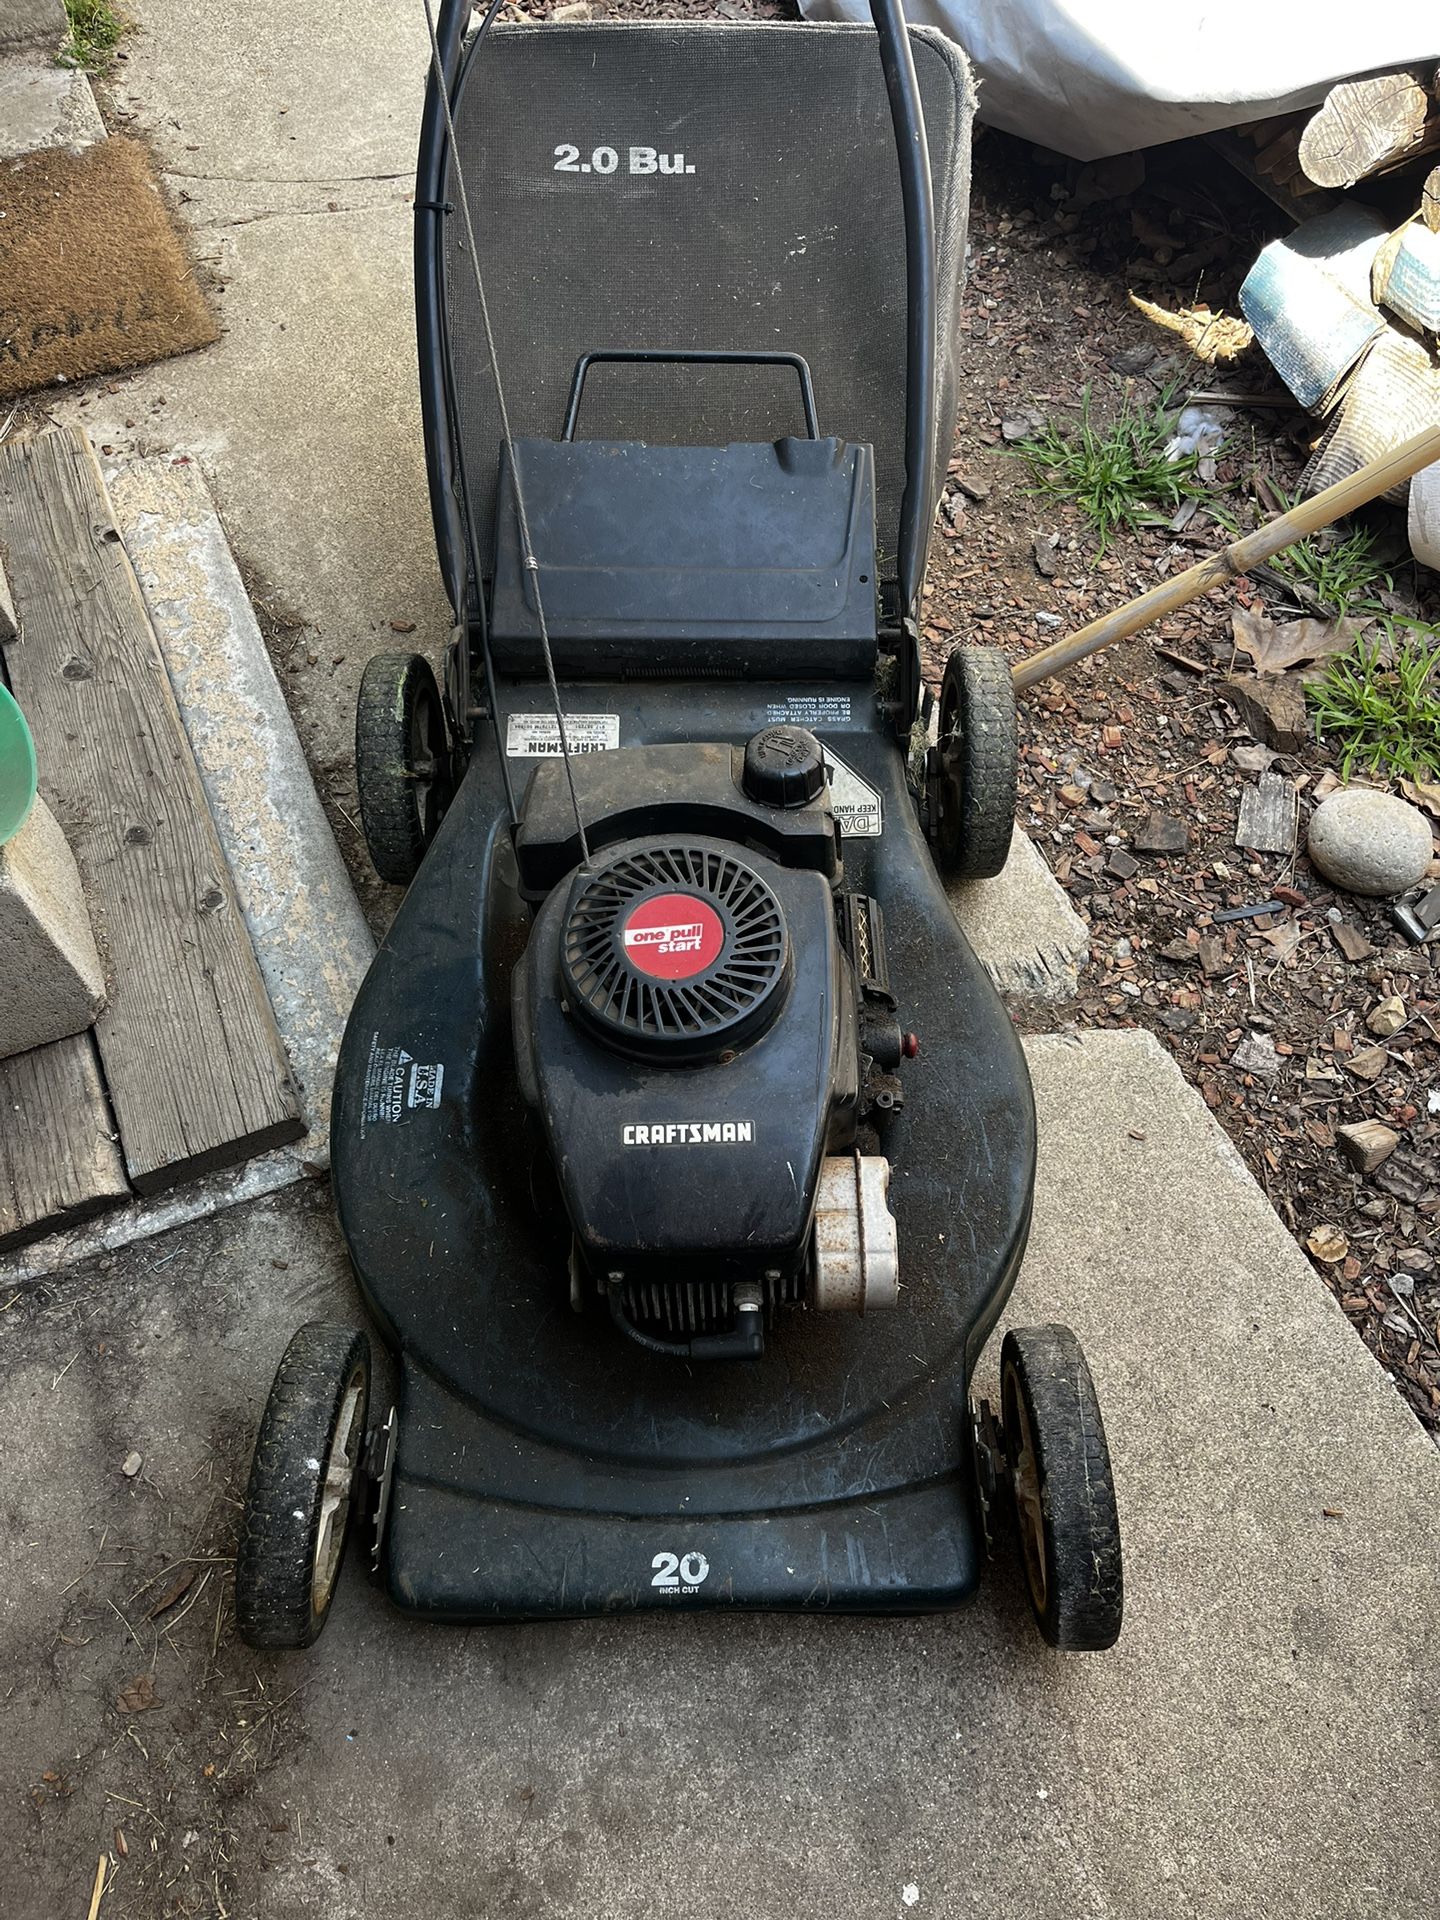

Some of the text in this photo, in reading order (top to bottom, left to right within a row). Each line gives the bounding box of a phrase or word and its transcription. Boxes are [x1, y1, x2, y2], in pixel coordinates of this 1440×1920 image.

[554, 143, 696, 174] 2.0 Bu.
[857, 804, 876, 812] KEEP
[633, 925, 701, 942] one pull
[658, 939, 701, 953] start
[392, 1068, 405, 1122] CAUTION
[426, 1064, 437, 1109] MADE IN
[623, 1122, 752, 1145] CRAFTSMAN
[651, 1551, 710, 1586] 20
[659, 1586, 680, 1594] INCH
